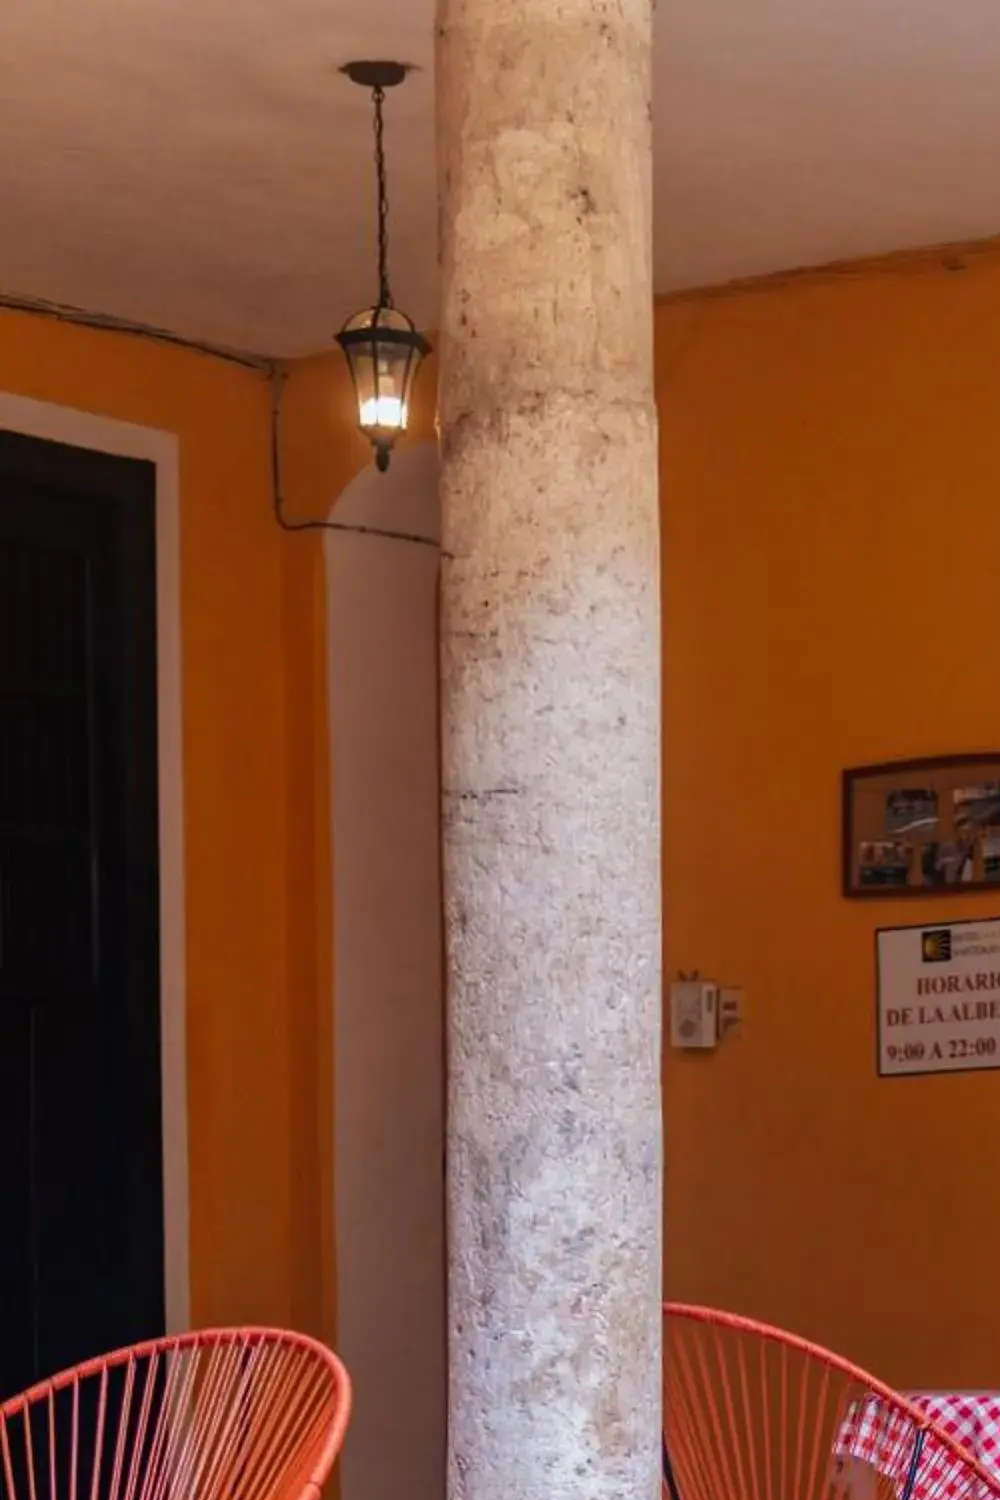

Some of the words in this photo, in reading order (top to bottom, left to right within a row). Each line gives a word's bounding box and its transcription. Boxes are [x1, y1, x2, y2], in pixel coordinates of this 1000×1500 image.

[886, 1006, 913, 1027] DE
[919, 1005, 945, 1025] LA
[886, 1040, 925, 1063] 9:00
[929, 1041, 943, 1061] A
[949, 1036, 997, 1059] 22:00
